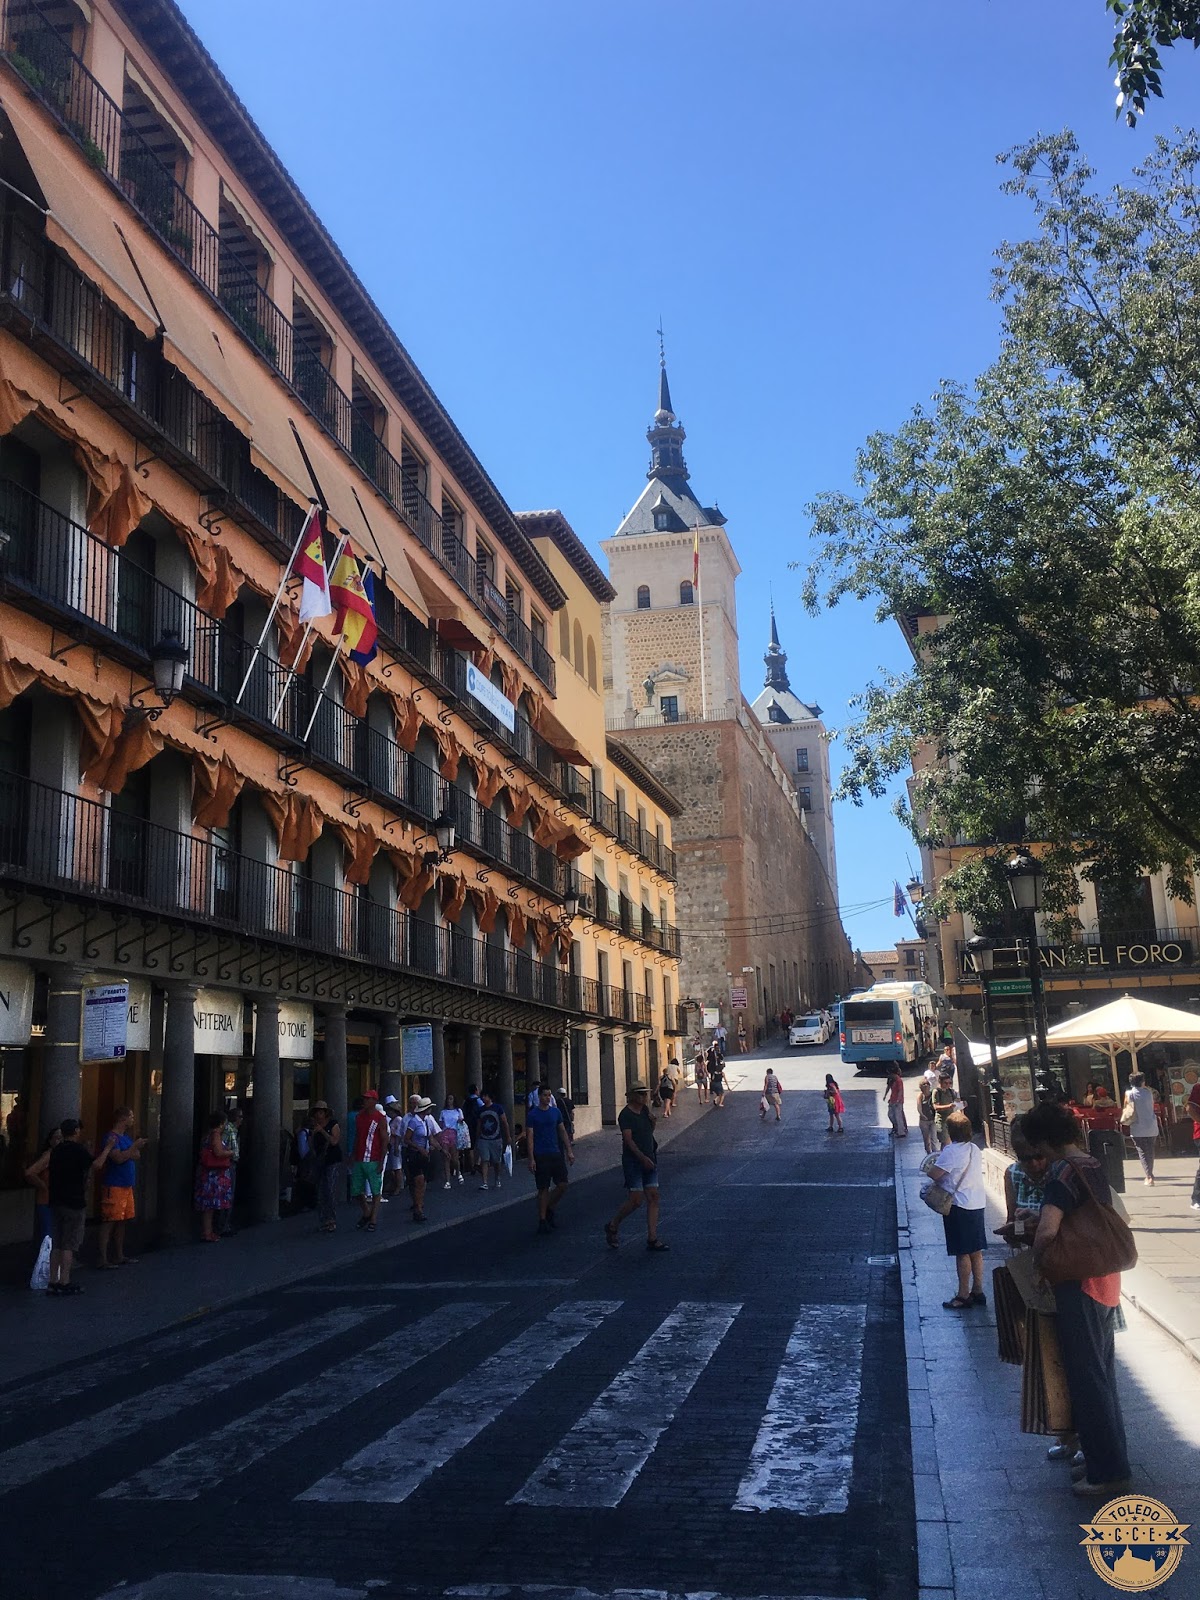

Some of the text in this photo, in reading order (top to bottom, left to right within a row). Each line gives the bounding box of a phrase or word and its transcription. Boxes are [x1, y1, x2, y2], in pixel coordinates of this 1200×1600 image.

[1037, 943, 1183, 968] ANEL FORO
[287, 1022, 307, 1038] TOMÉ
[117, 1047, 122, 1055] 5
